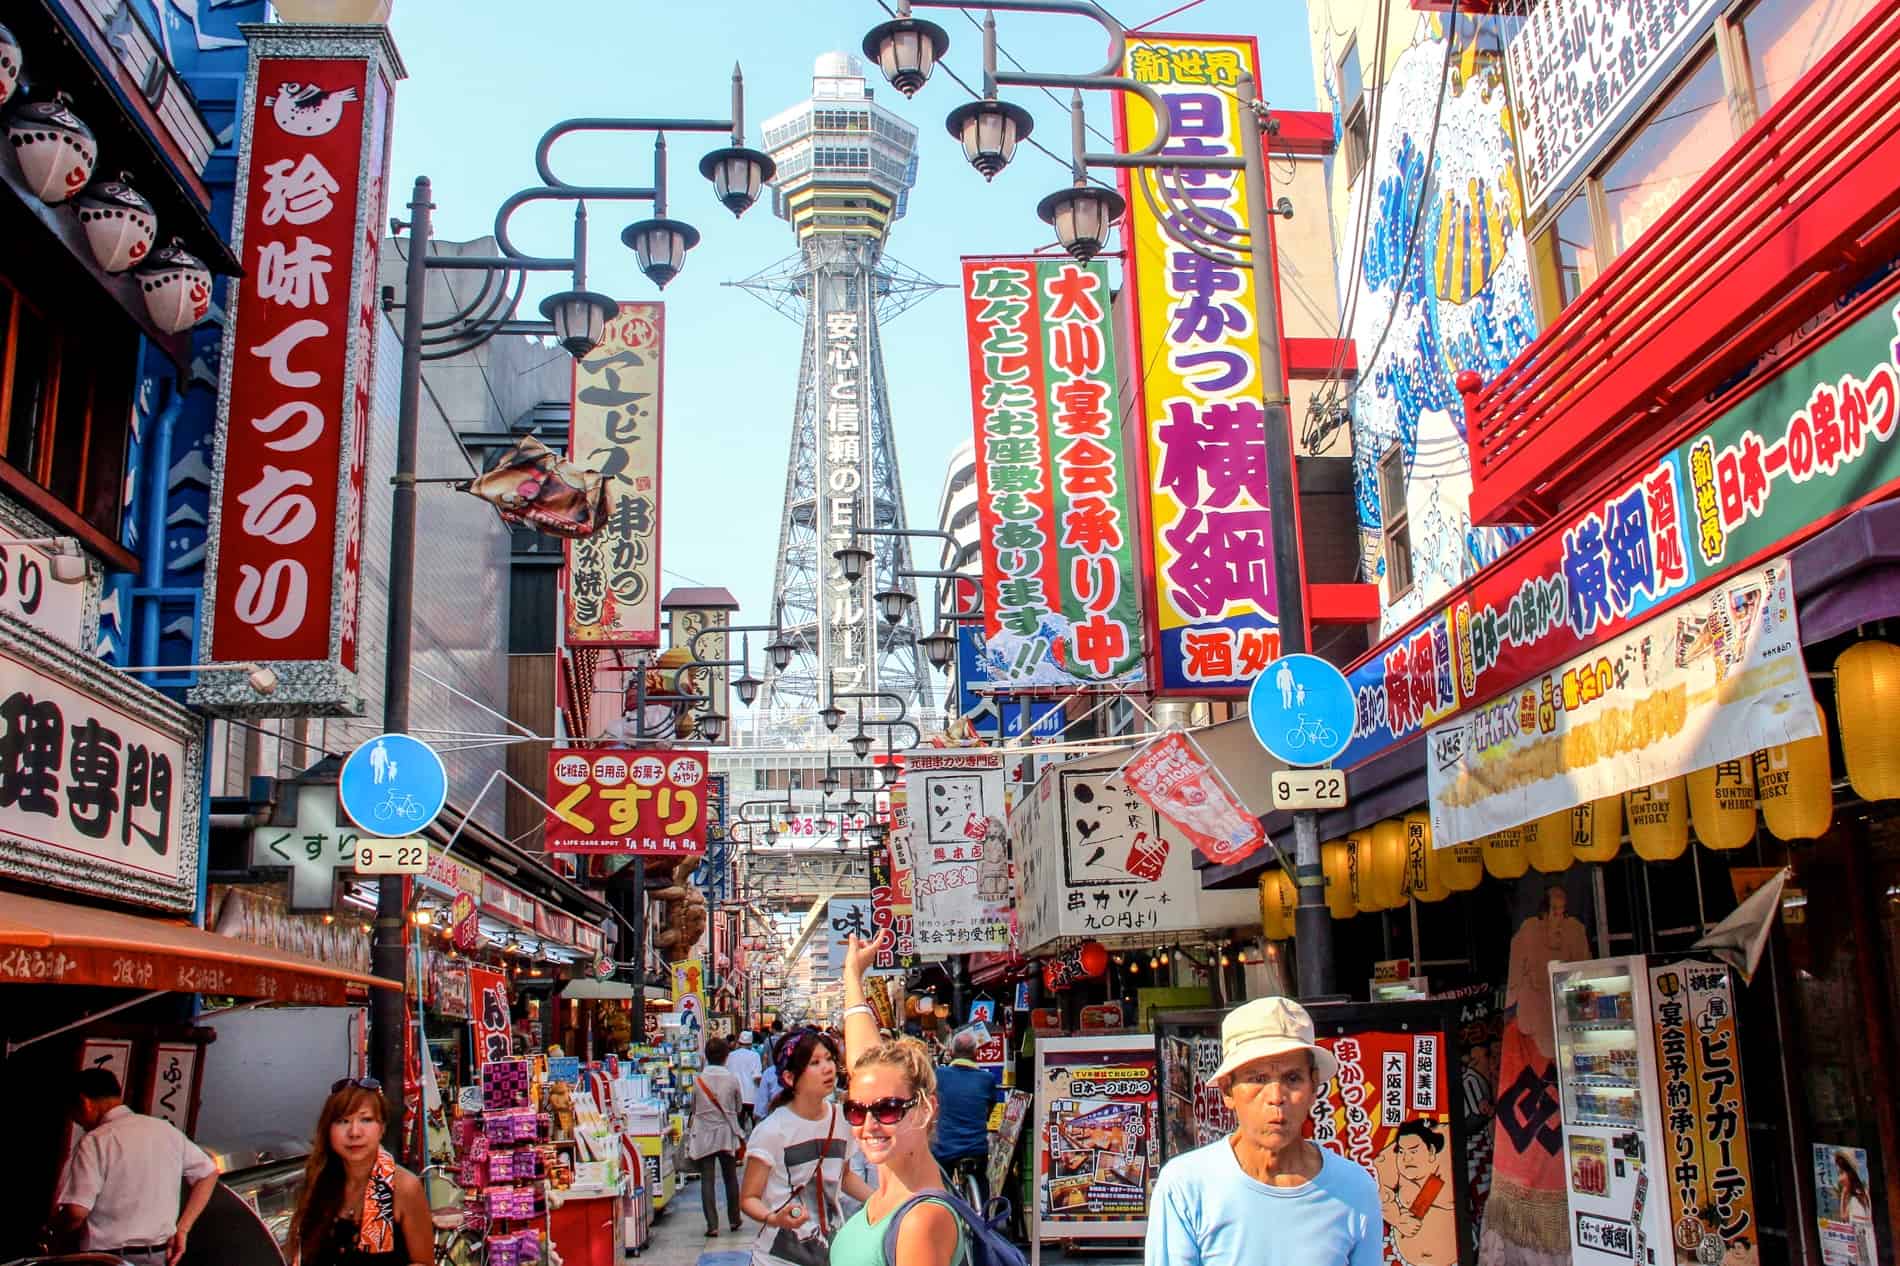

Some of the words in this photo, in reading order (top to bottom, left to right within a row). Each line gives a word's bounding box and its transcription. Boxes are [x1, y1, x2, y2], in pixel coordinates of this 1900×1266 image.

[1132, 47, 1241, 86] 新世界
[1160, 92, 1250, 391] 日本一の串かつ
[1716, 370, 1895, 526] 日本一の串かつ
[1159, 401, 1279, 618] 横綱
[1647, 469, 1686, 587] 酒処
[1692, 441, 1724, 558] 新世界
[608, 493, 654, 606] 串かつ
[1564, 489, 1656, 634] 横綱
[1185, 632, 1280, 677] 酒処
[1472, 576, 1566, 669] 日本一の串かつ
[1384, 630, 1437, 735] 横綱
[594, 764, 626, 779] 日用品
[632, 764, 664, 779] お菓子
[554, 783, 698, 837] くすり
[269, 832, 359, 862] くすり
[1408, 823, 1426, 890] 角ハイボール
[1067, 889, 1139, 911] 串カツ
[1084, 913, 1158, 928] 九〇円より
[919, 925, 1008, 944] 宴会予約受付中
[1072, 1081, 1151, 1095] 日本一の串かつ
[1385, 1056, 1404, 1124] 大阪名物
[1416, 1040, 1434, 1106] 超絶美味
[1659, 1001, 1700, 1216] 宴会予約承り中!!
[1701, 1031, 1750, 1240] ビアガーデン
